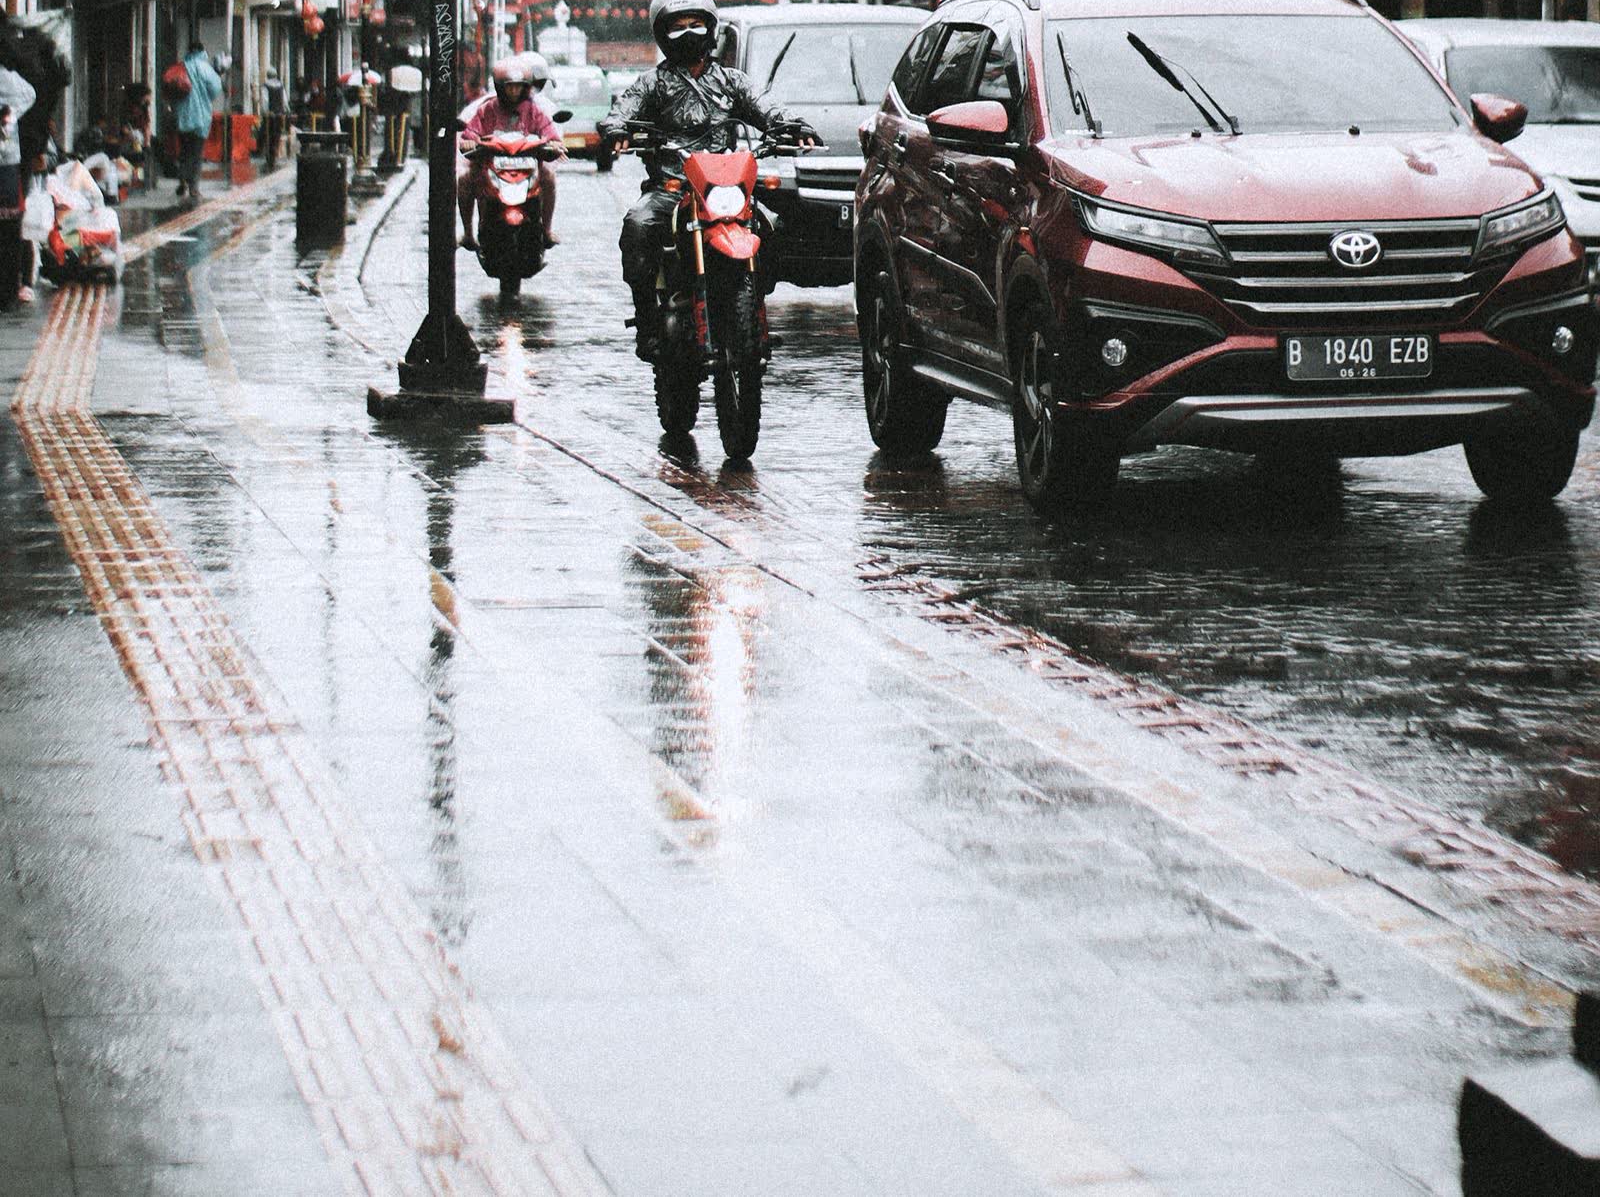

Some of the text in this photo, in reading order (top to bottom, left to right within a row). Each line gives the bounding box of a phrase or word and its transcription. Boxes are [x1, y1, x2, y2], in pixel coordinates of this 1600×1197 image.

[841, 205, 849, 220] B
[1289, 337, 1429, 366] B 1840 EZB
